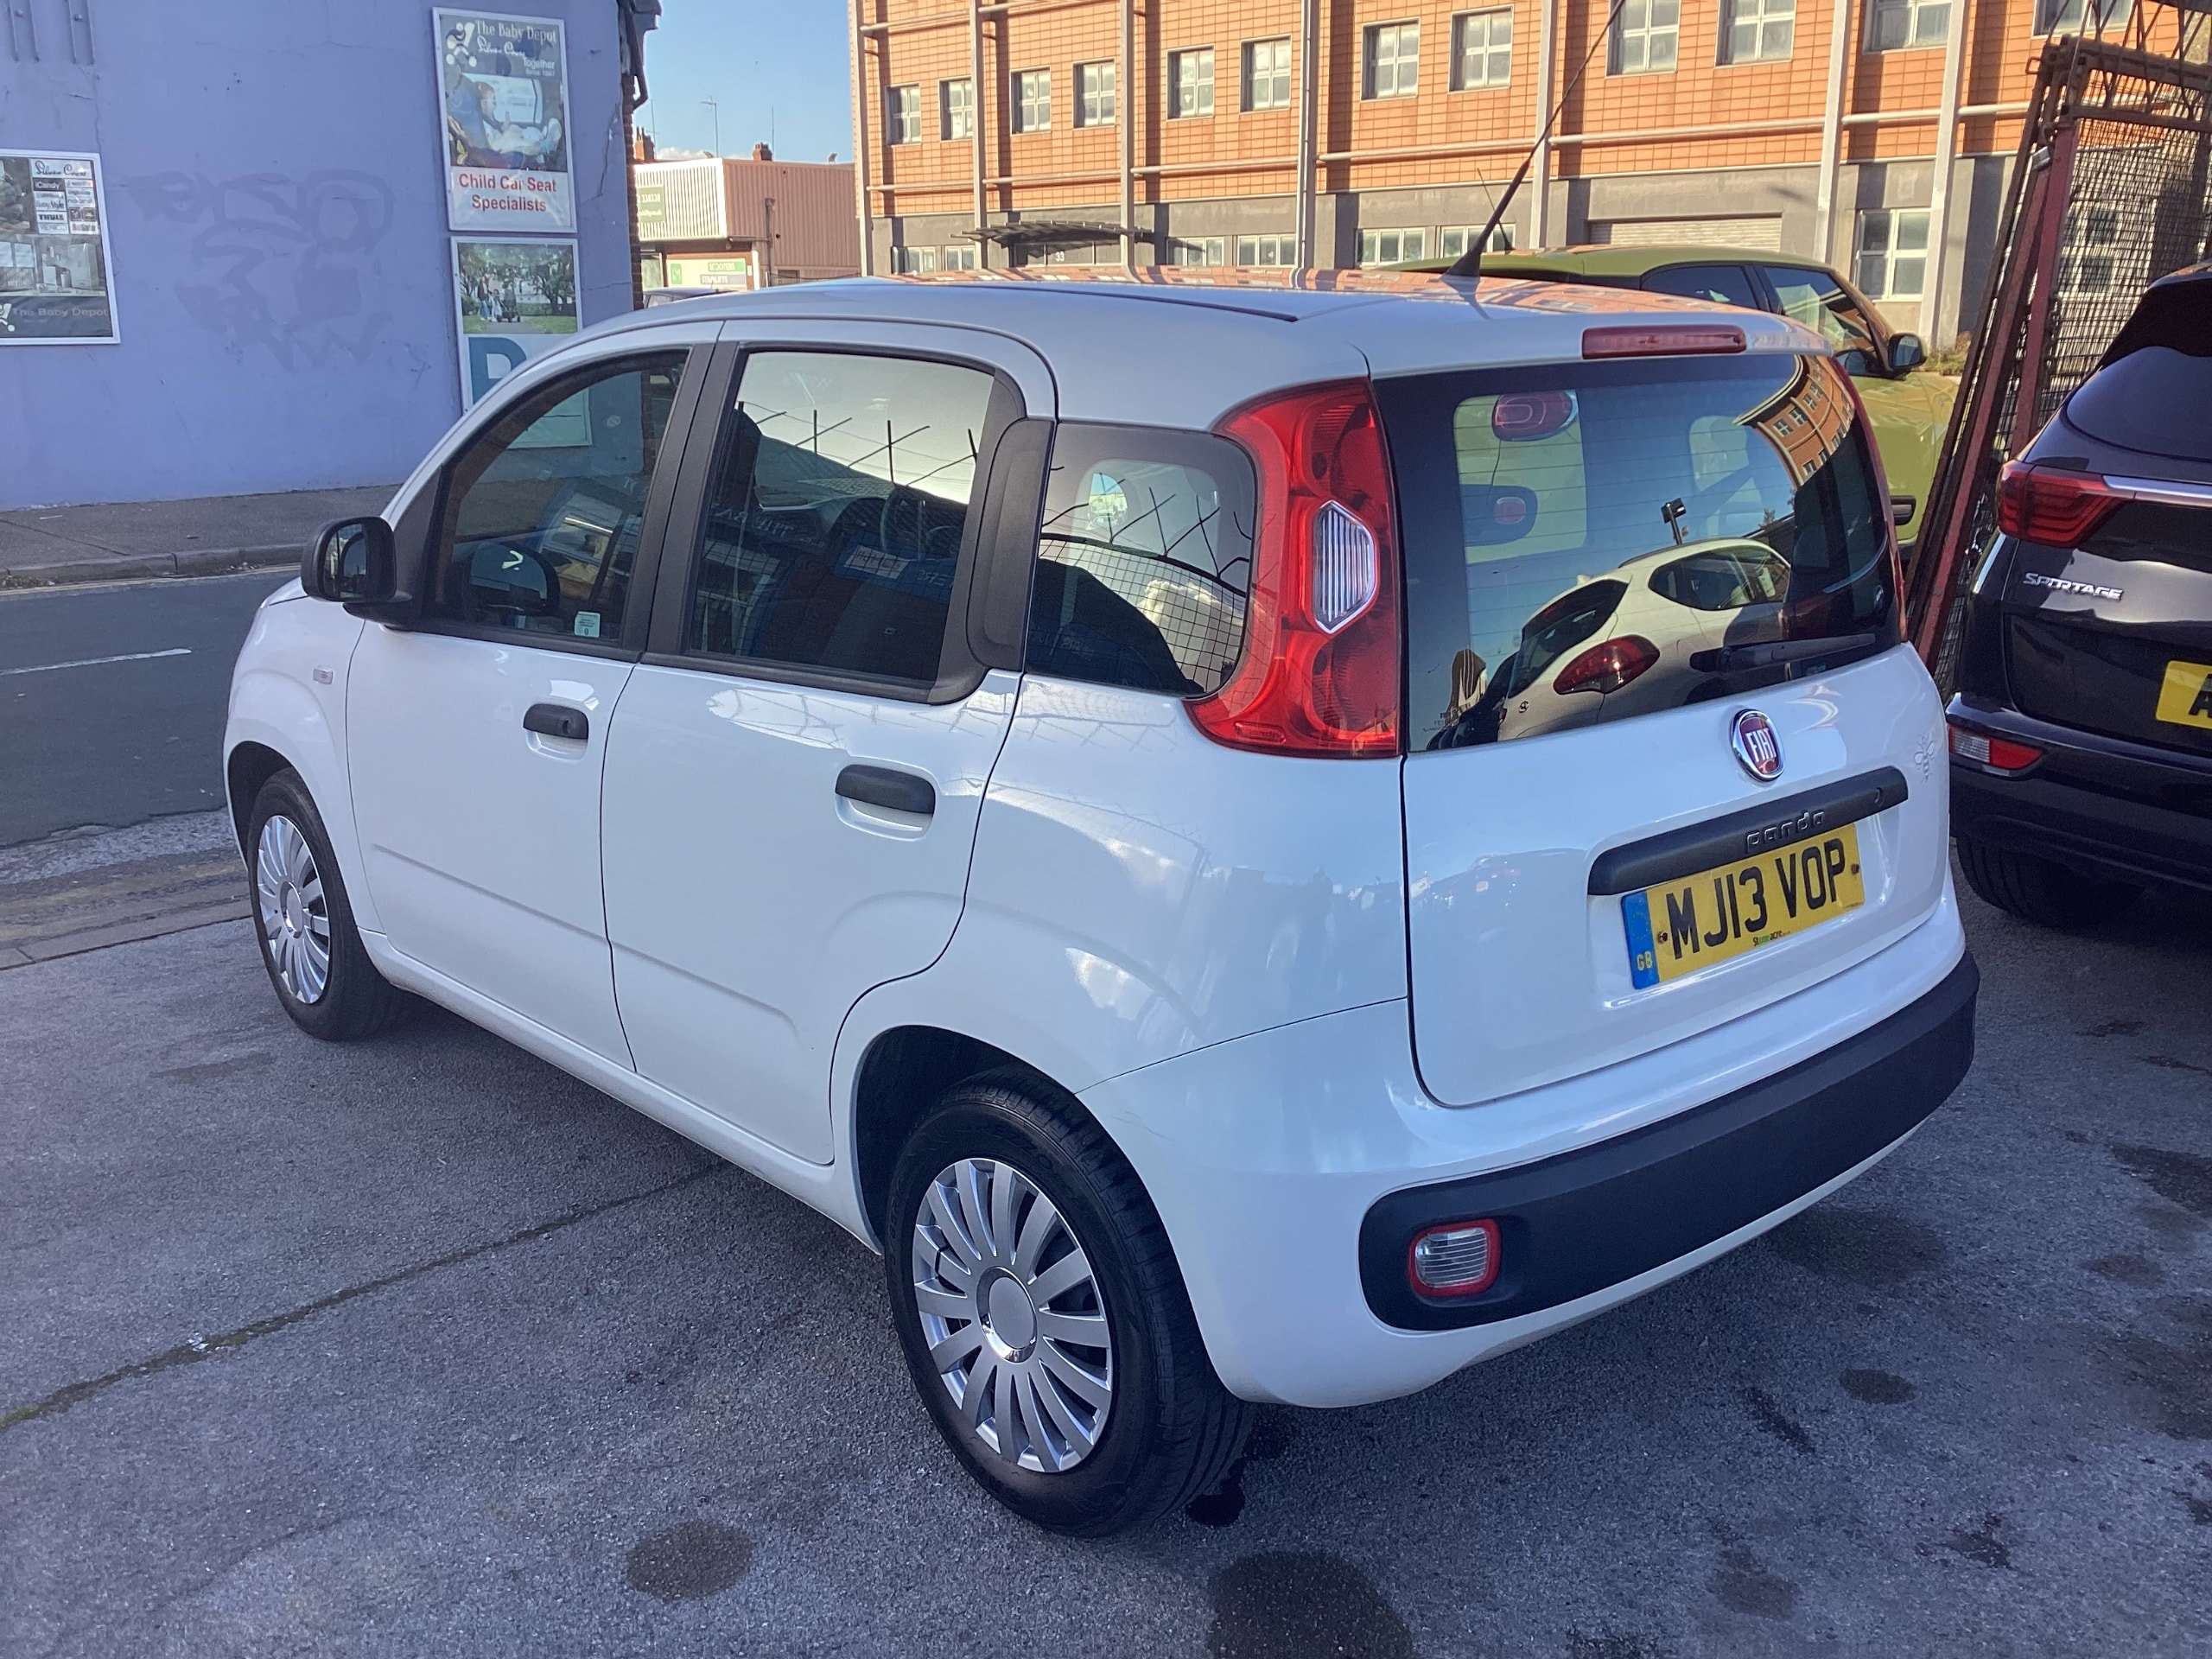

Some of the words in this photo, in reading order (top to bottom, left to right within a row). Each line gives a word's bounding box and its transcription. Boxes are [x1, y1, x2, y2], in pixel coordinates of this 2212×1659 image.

[475, 20, 495, 35] The
[499, 22, 524, 41] Baby
[526, 25, 556, 45] Depot
[459, 173, 496, 189] Child
[499, 175, 522, 191] Car
[527, 176, 557, 193] Seat
[472, 194, 547, 213] Specialists
[37, 308, 68, 318] Baby
[72, 305, 109, 317] Depot
[2023, 572, 2123, 600] SPORTAGE
[1745, 727, 1777, 763] FIAT
[1745, 810, 1825, 855] panda
[1665, 866, 1768, 961] MJ13
[1775, 837, 1846, 919] VOP
[1637, 950, 1653, 972] GB
